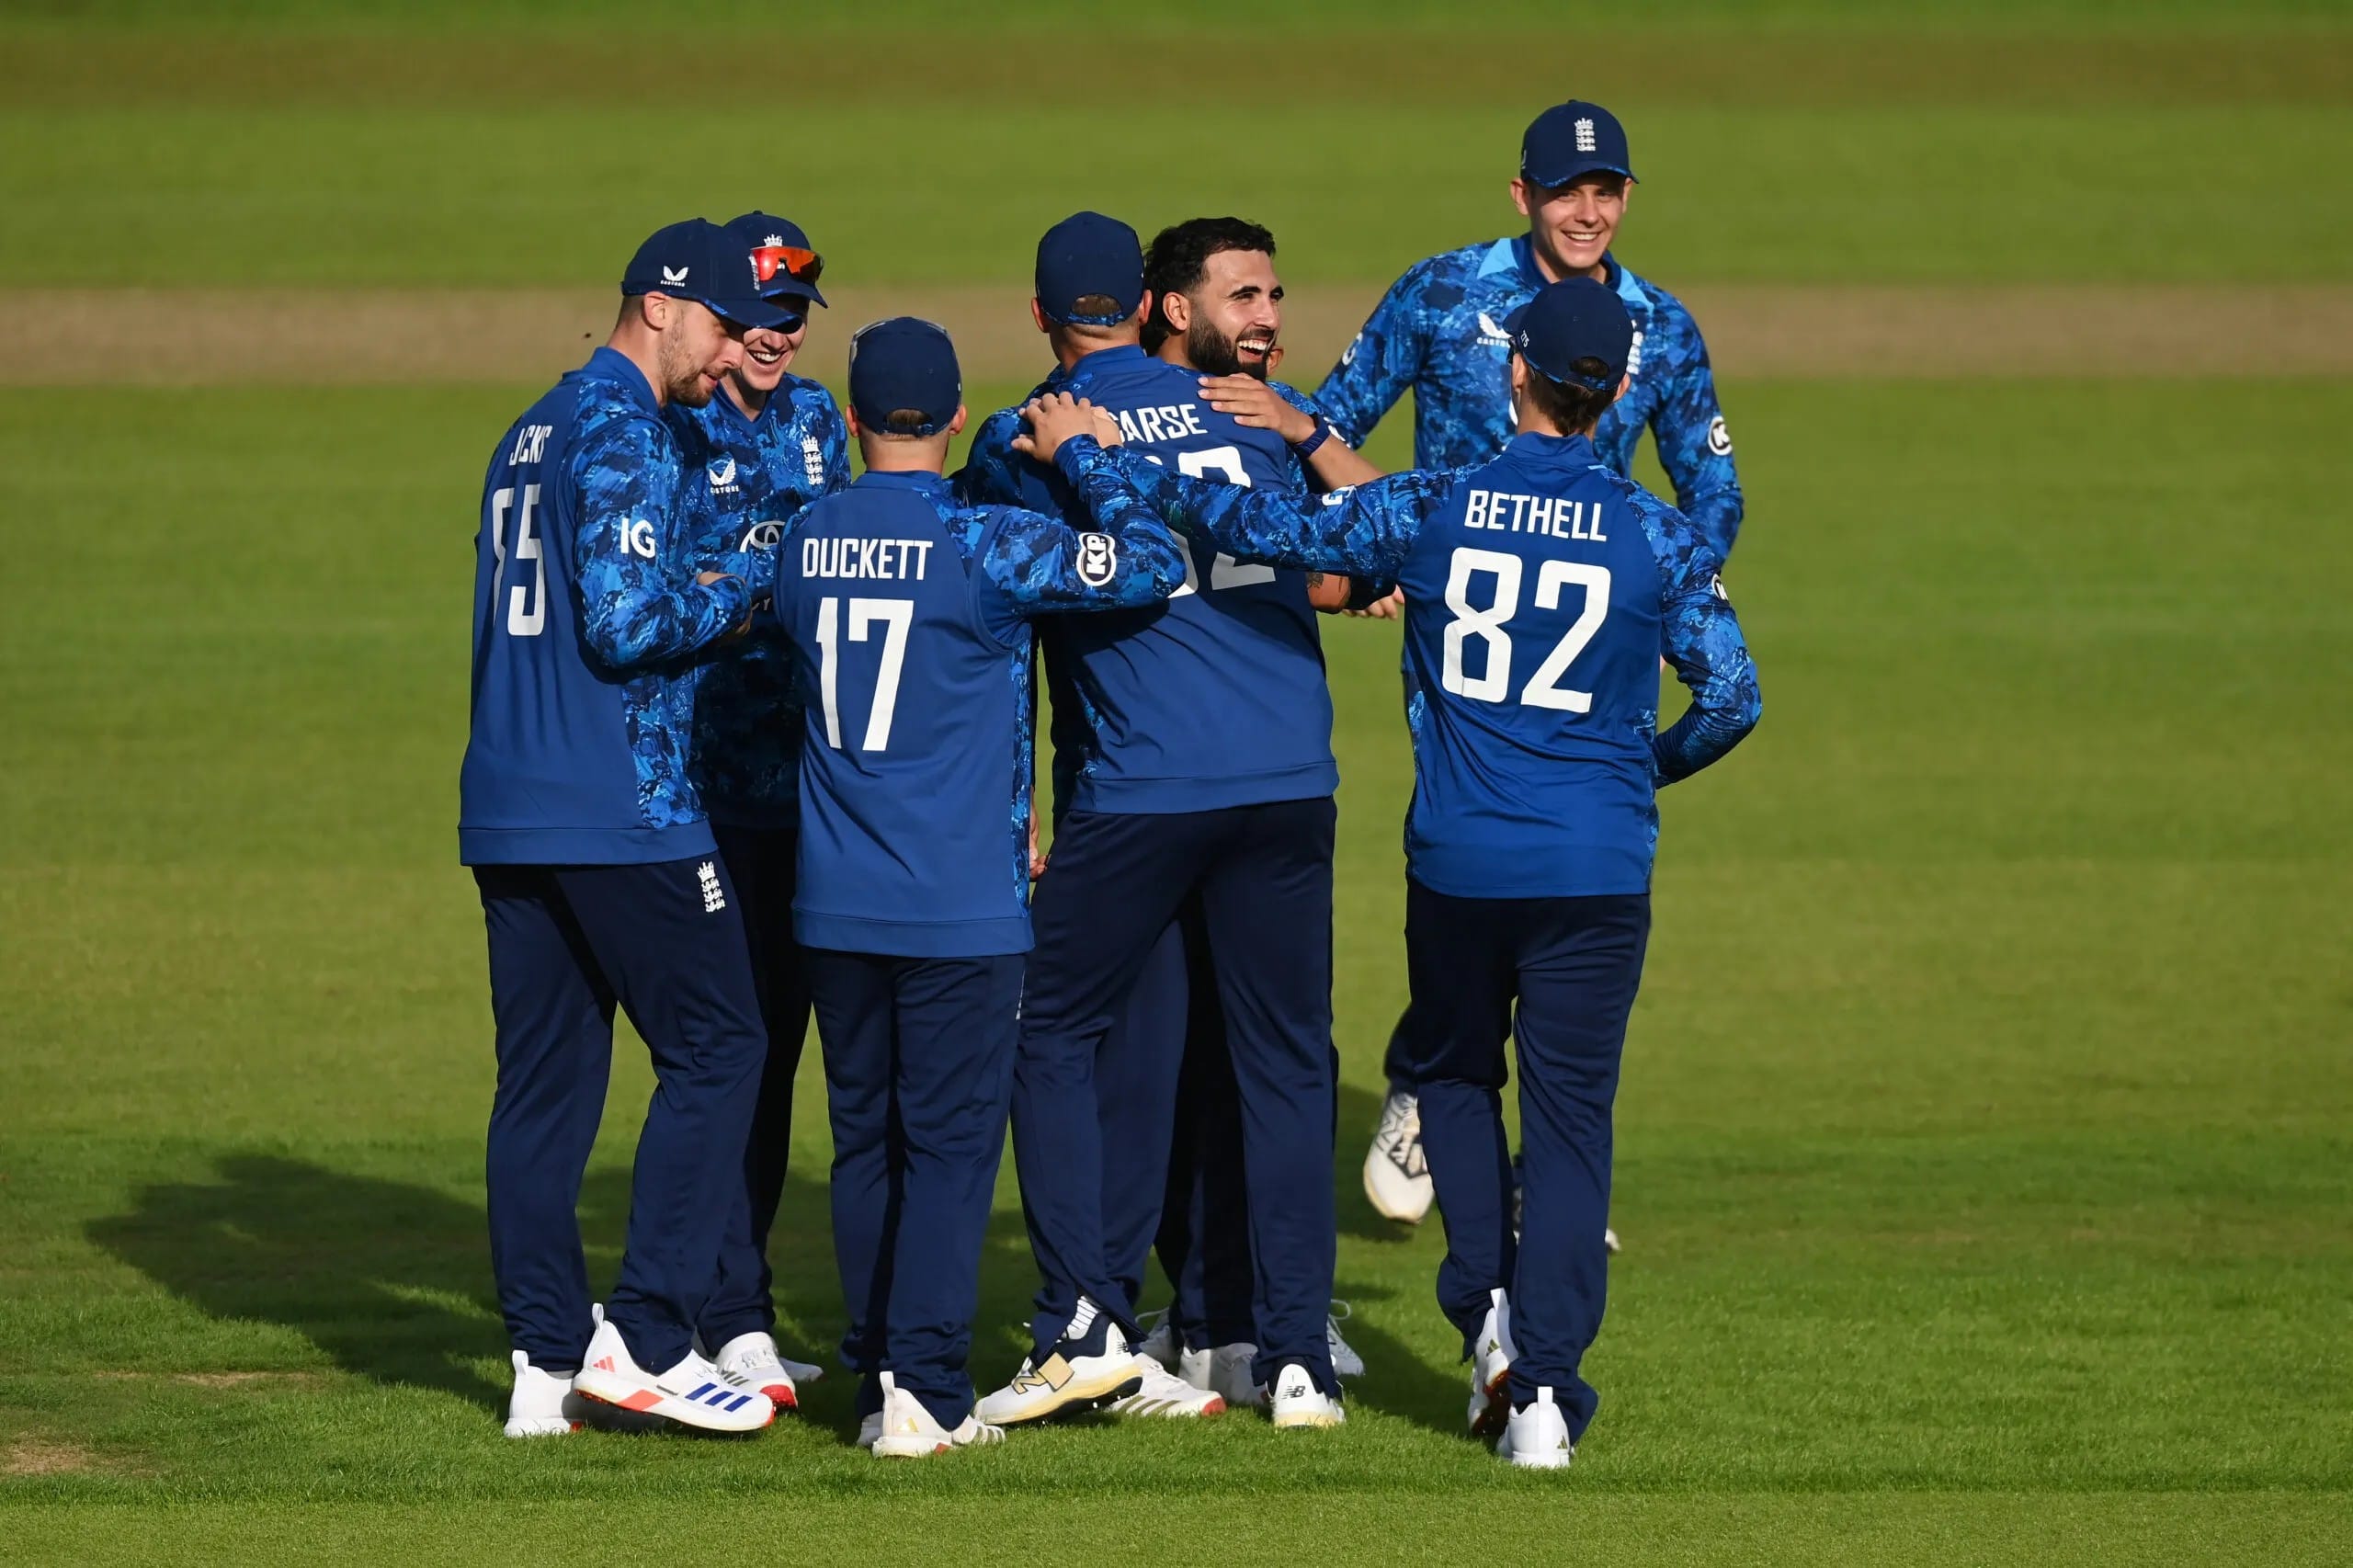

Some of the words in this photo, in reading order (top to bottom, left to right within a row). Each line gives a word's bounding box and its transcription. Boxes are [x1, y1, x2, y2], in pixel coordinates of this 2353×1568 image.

[508, 425, 553, 466] JCKS
[620, 517, 656, 558] IG
[1463, 490, 1608, 542] BETHELL
[802, 538, 934, 581] DUCKETT
[1441, 547, 1611, 713] 82
[815, 597, 915, 751] 17
